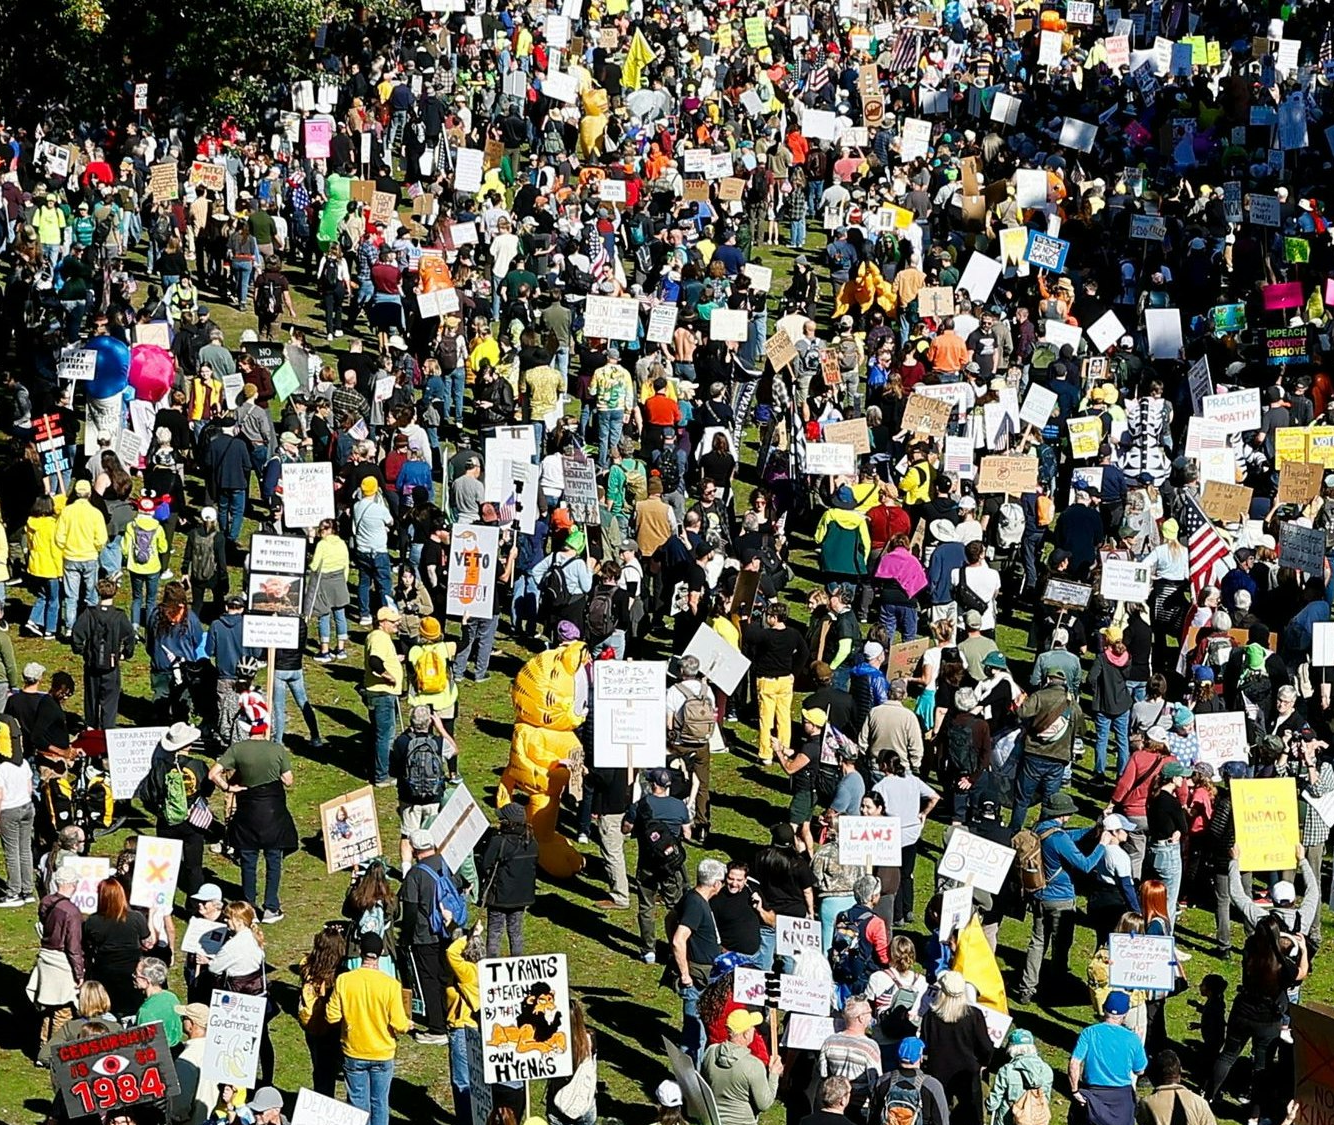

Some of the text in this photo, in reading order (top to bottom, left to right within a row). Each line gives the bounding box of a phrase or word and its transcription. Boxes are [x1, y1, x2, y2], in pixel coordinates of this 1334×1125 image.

[1267, 328, 1307, 338] IMPEACH
[1267, 338, 1306, 348] CONVICT
[258, 348, 272, 357] NO
[1269, 346, 1306, 357] REMOVE
[1207, 393, 1257, 408] PRACTICE
[566, 481, 592, 490] TRUTH
[1198, 723, 1244, 738] BOYCOTT
[1201, 737, 1239, 751] ORGAN
[1217, 748, 1234, 758] IZE
[1243, 810, 1288, 823] UNPAID
[849, 829, 893, 841] LAWS
[957, 833, 1012, 868] RESIST
[793, 921, 812, 930] NO
[485, 955, 558, 983] TYRANTS
[1132, 961, 1154, 970] NOT
[1123, 972, 1157, 981] TRUMP
[210, 1013, 259, 1033] Government
[57, 1023, 159, 1062] CENSORSHIP
[489, 1050, 514, 1064] OWN
[69, 1062, 87, 1079] IS
[495, 1057, 557, 1083] HYENAS
[70, 1066, 166, 1114] 1984
